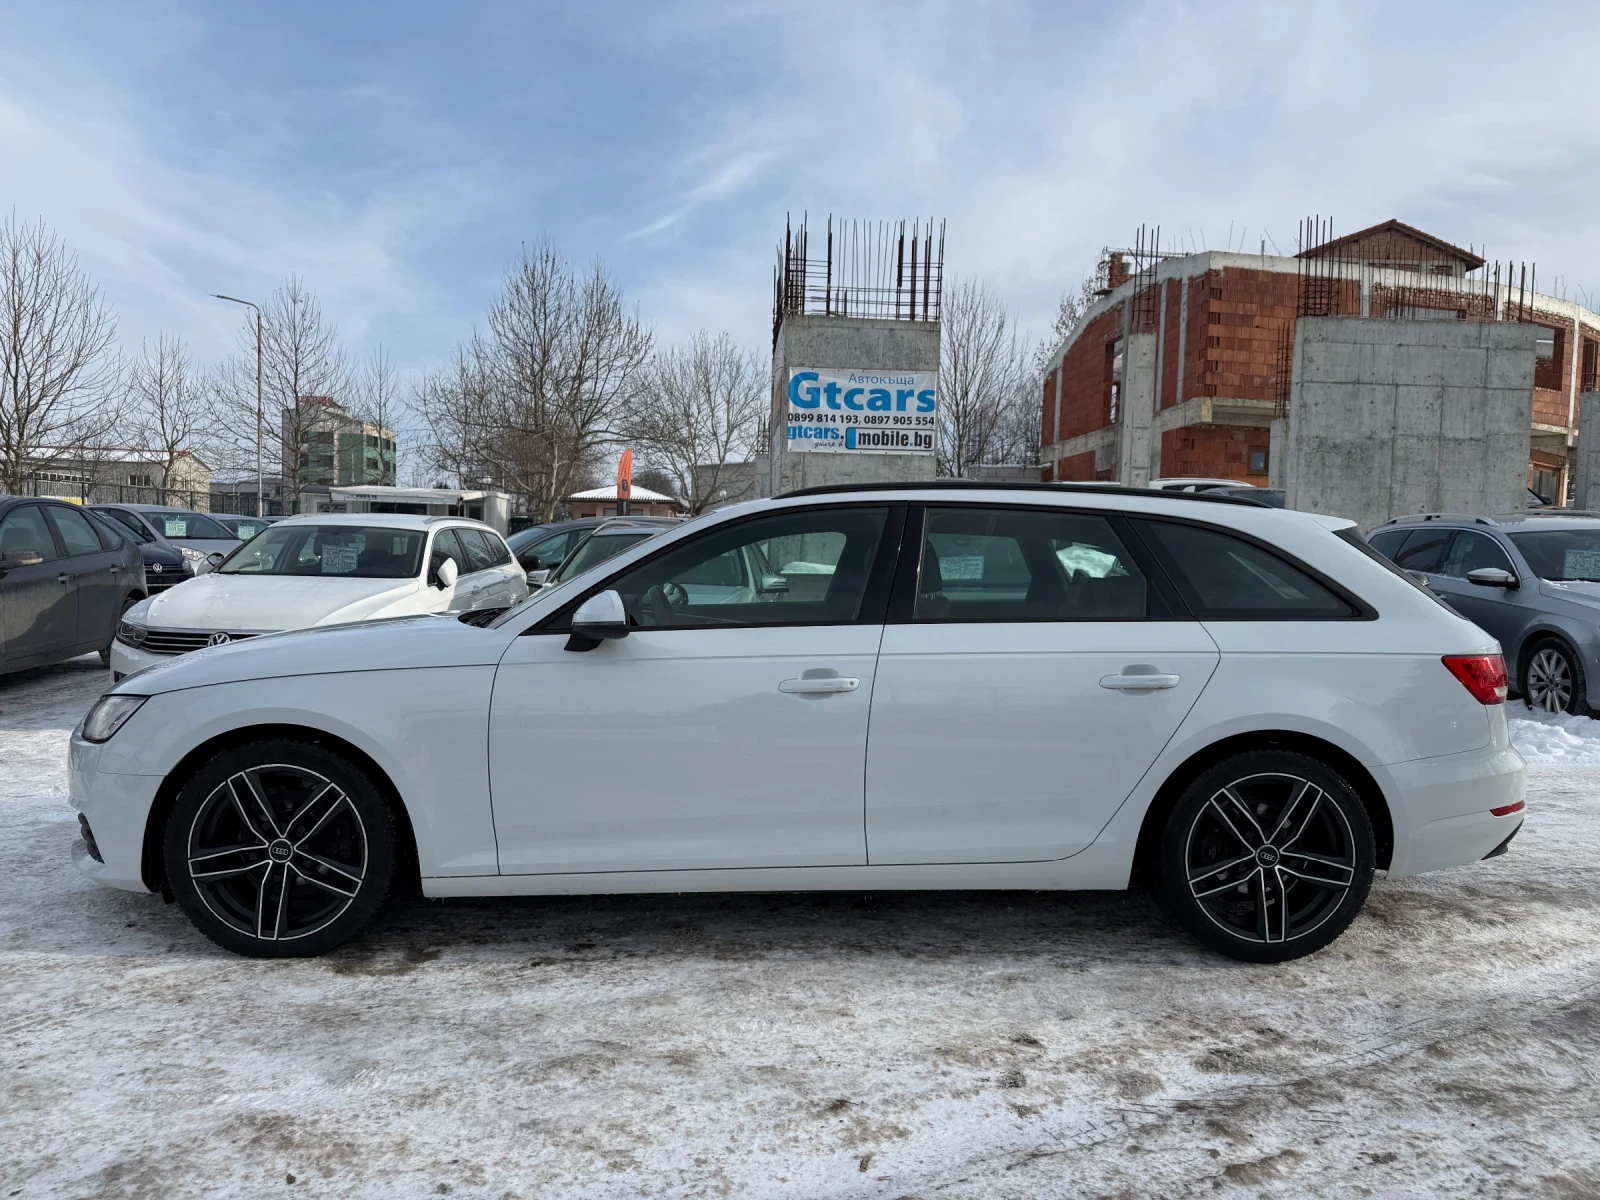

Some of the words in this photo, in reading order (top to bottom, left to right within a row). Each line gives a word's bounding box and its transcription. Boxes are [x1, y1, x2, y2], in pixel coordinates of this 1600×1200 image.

[848, 373, 915, 386] Автокъща
[788, 371, 936, 413] Gtcars
[787, 413, 814, 423] 0899
[816, 413, 837, 423] 814
[839, 414, 861, 425] 193,
[863, 415, 891, 425] 0897
[892, 416, 913, 425] 905
[915, 416, 935, 426] 554
[858, 430, 933, 449] mobile.bg
